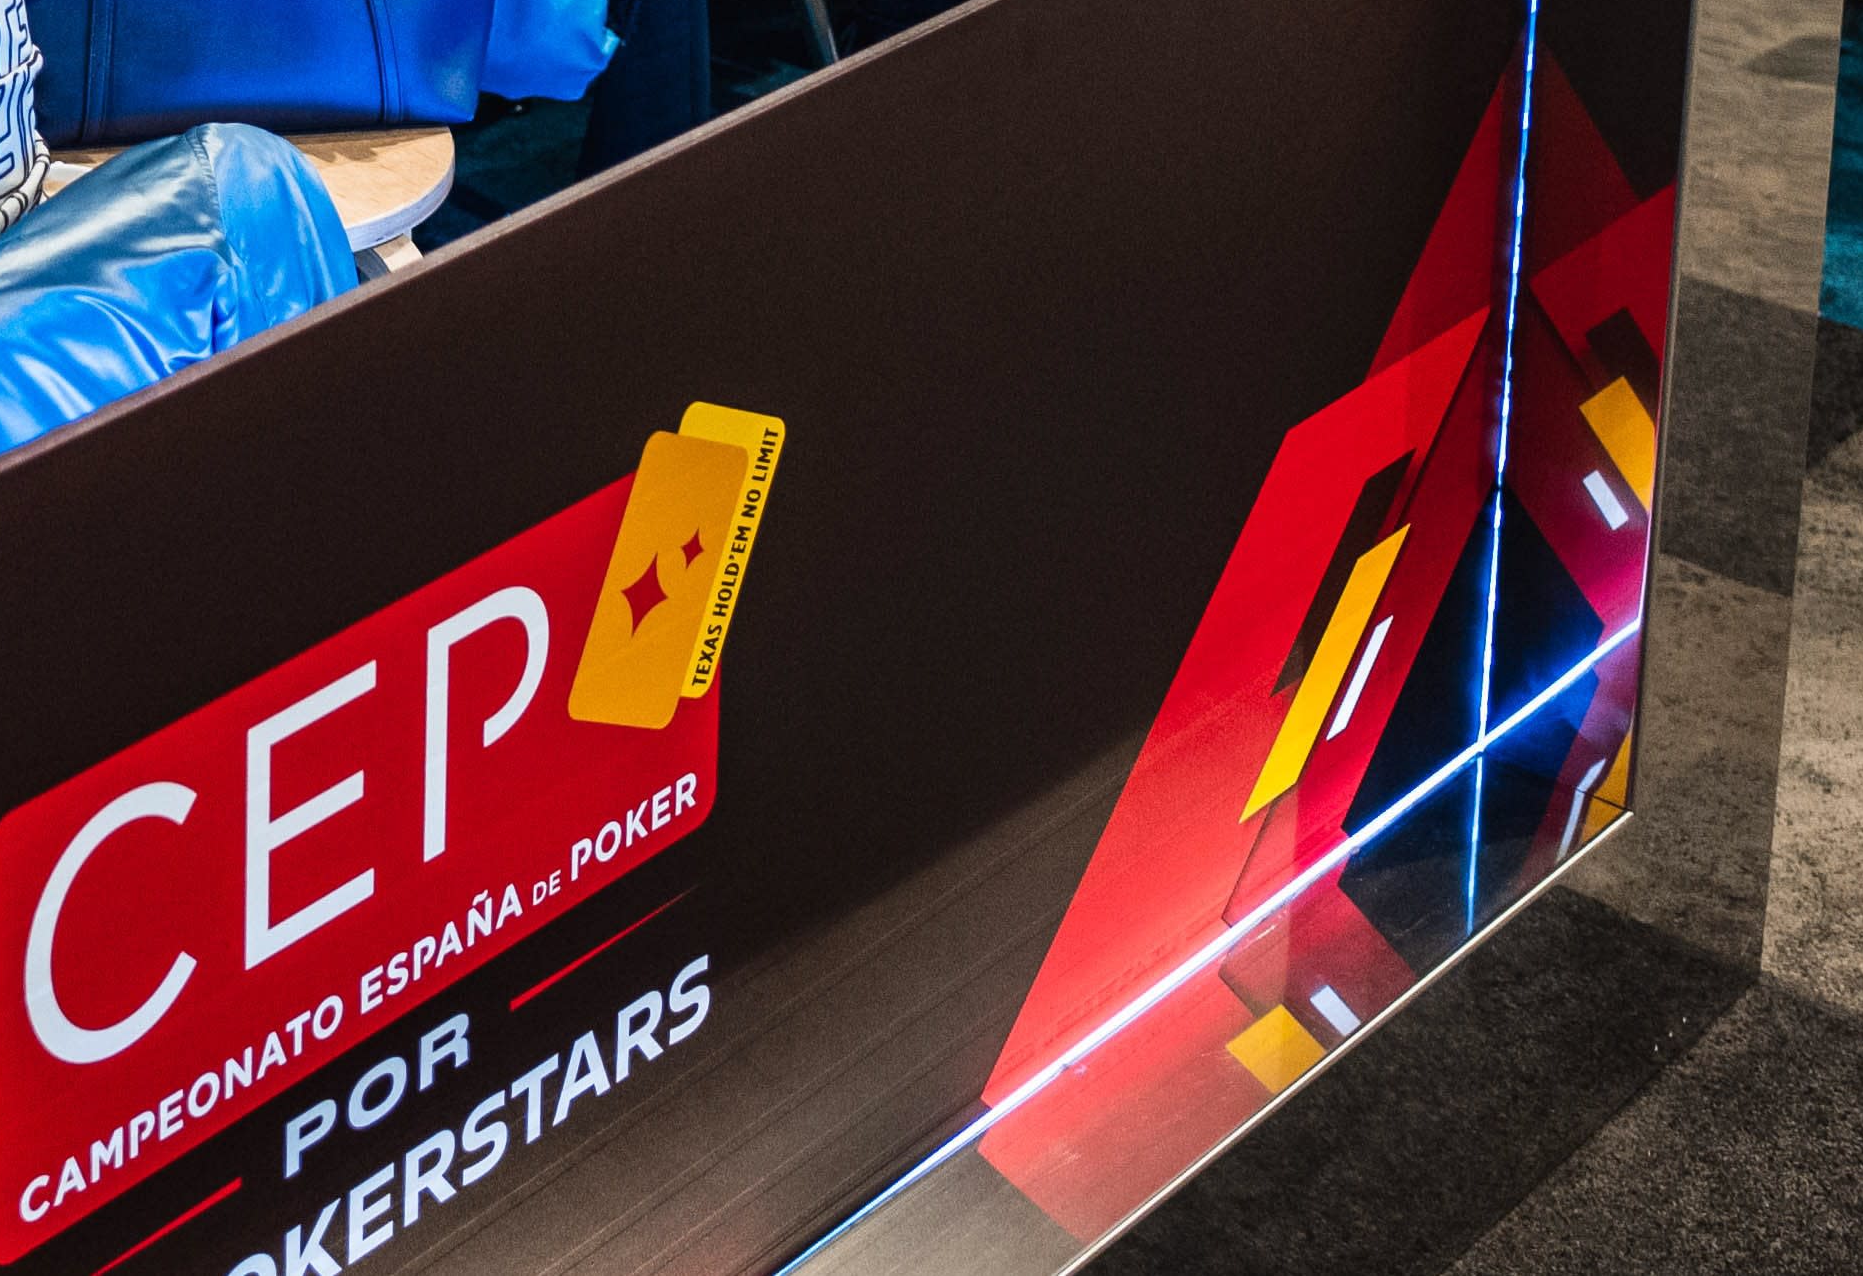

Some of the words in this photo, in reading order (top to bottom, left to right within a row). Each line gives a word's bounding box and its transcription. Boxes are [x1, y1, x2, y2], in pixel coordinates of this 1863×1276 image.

[741, 488, 762, 519] NO
[751, 426, 780, 483] LIMIT
[692, 623, 723, 688] TEXAS
[21, 584, 552, 1064] CEP
[18, 993, 345, 1225] CAMPEONATO
[358, 883, 523, 1016] ESPAÑA
[530, 867, 562, 907] DE
[568, 772, 700, 882] POKER
[227, 954, 712, 1276] KERSTARS
[284, 1010, 473, 1178] POR
